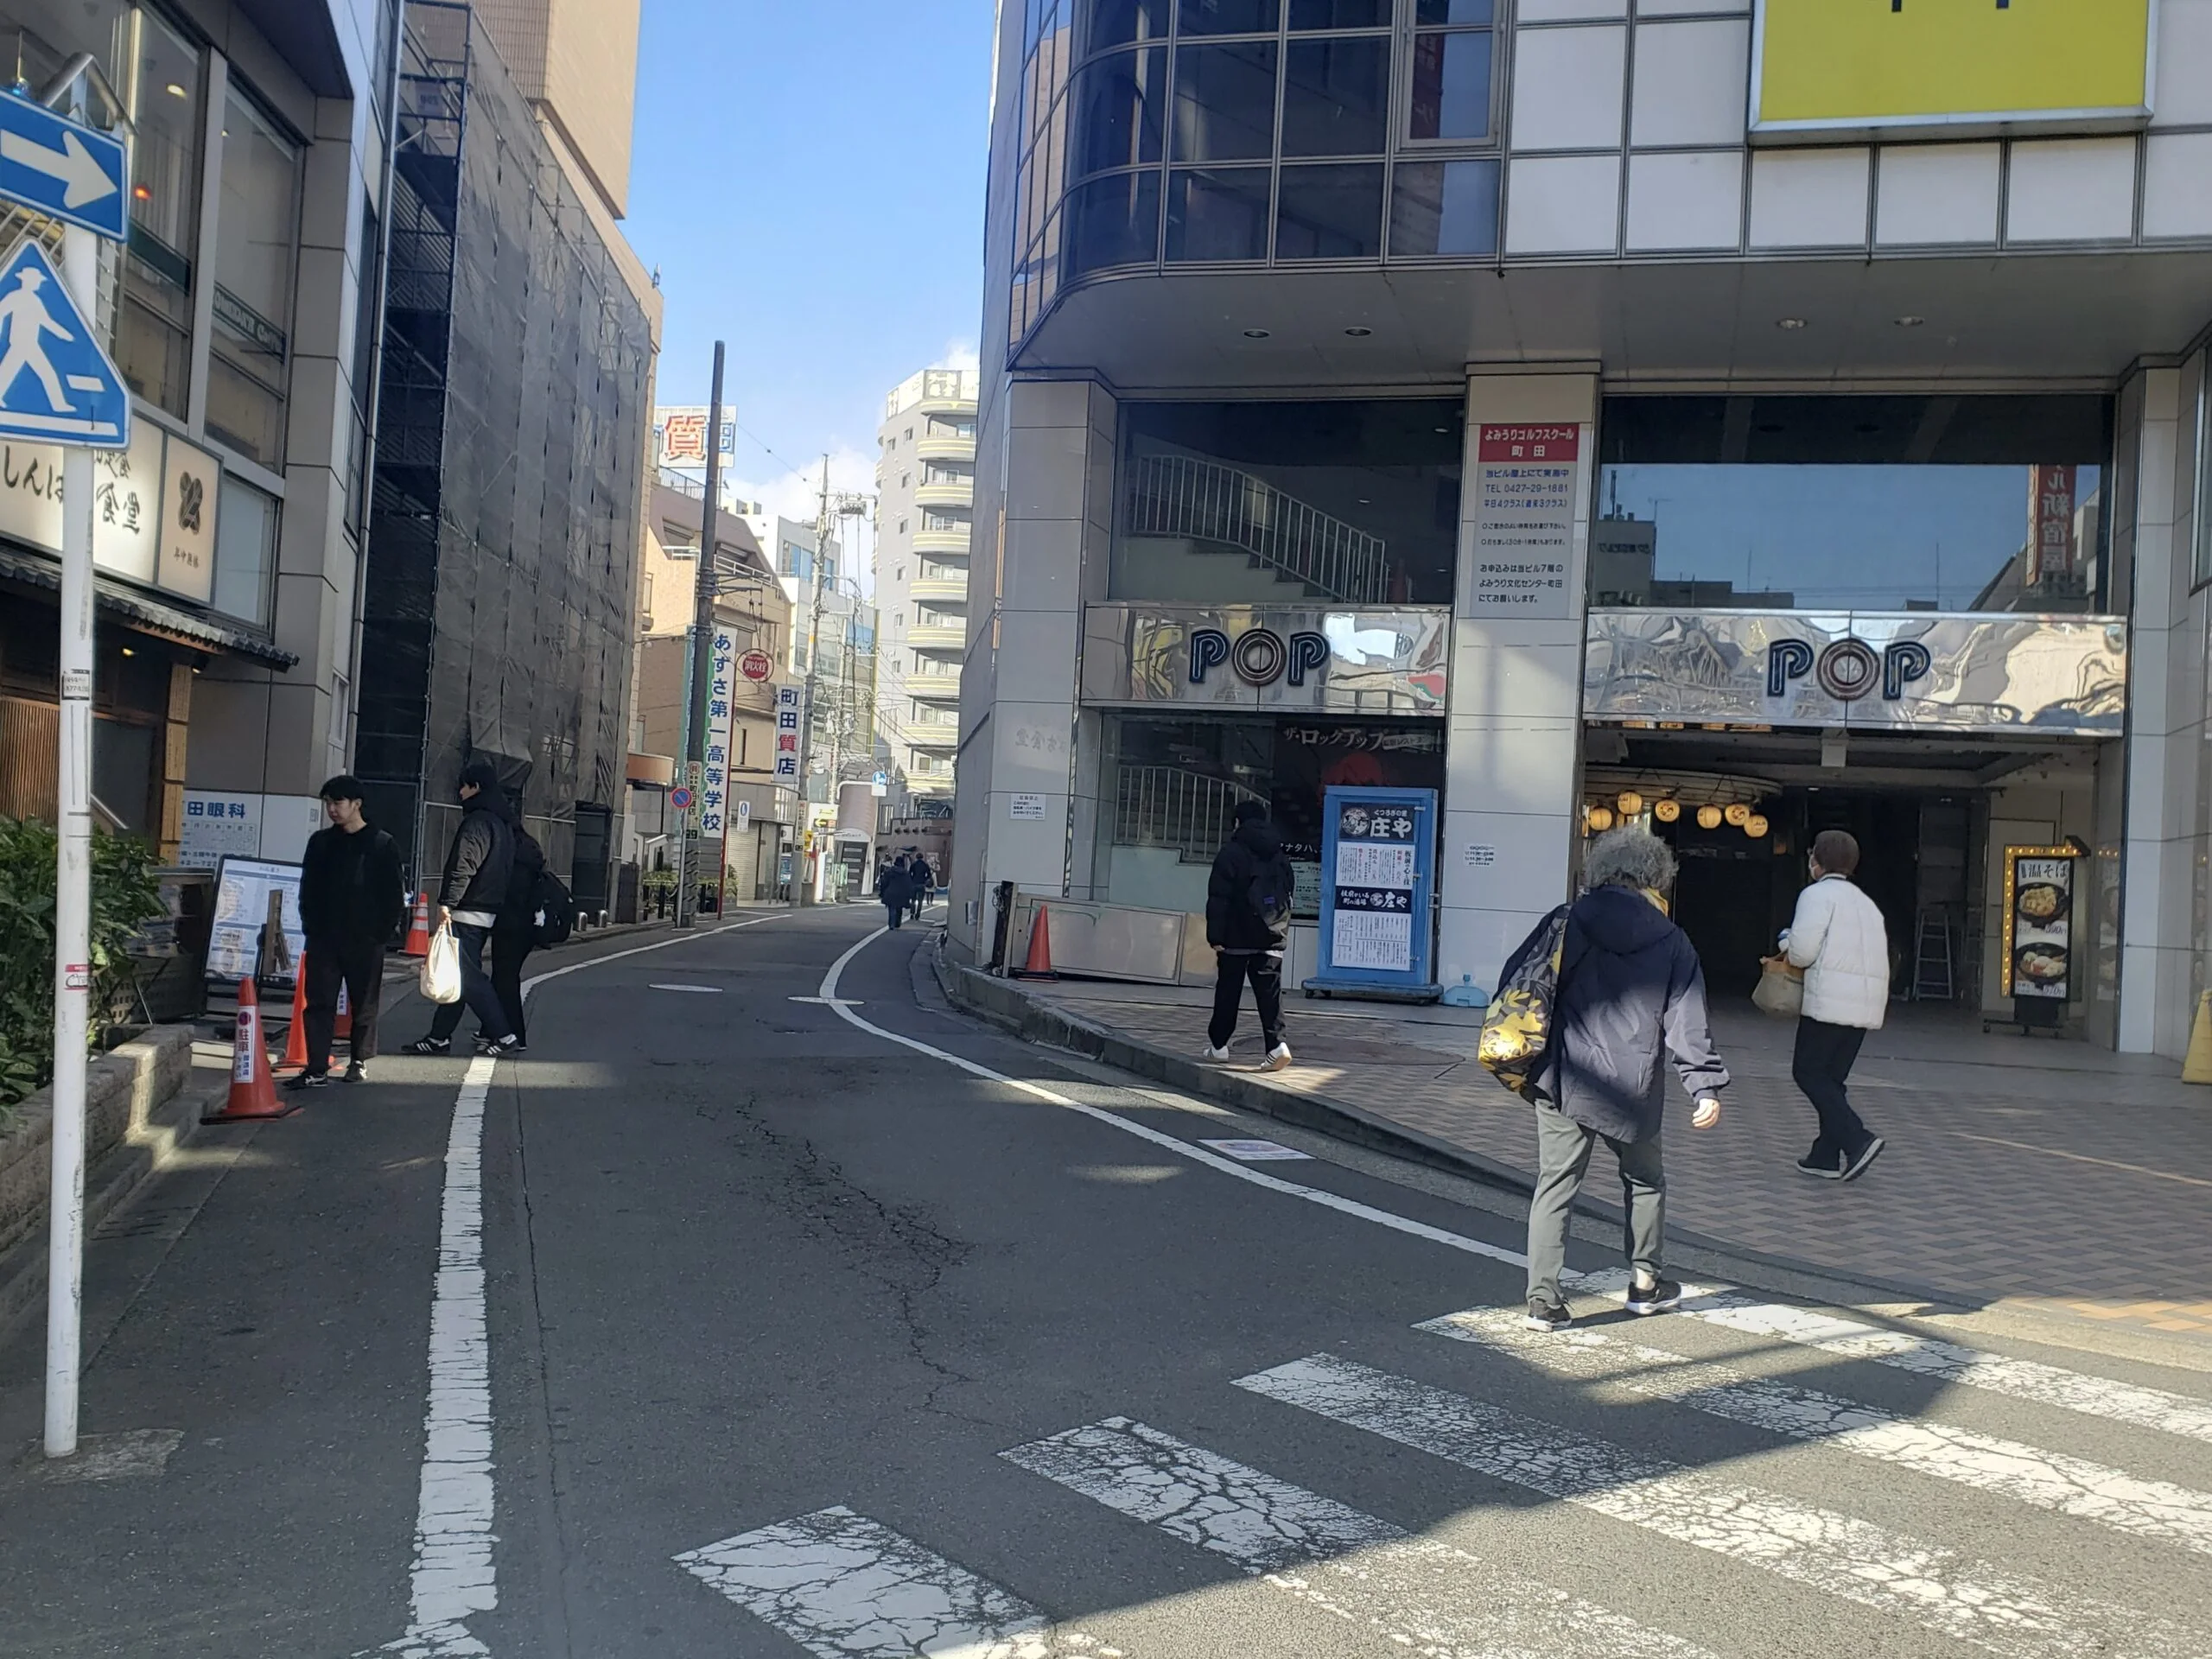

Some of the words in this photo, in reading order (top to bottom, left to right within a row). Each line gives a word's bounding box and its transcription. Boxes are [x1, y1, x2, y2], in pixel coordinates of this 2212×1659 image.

[1484, 429, 1573, 441] よみうりゴルフスクール
[1511, 445, 1546, 457] 町田
[1486, 484, 1501, 493] TEL
[1479, 579, 1562, 588] よみうり文化センター町田
[1478, 594, 1538, 603] にてお願いします。
[744, 659, 767, 672] 消火栓
[1189, 628, 1332, 687] POP
[1767, 638, 1931, 701] POP
[702, 633, 732, 832] あずさ第一高等学校
[778, 688, 799, 775] 町田質店
[182, 800, 245, 819] 田眼科
[1370, 817, 1413, 838] 庄や
